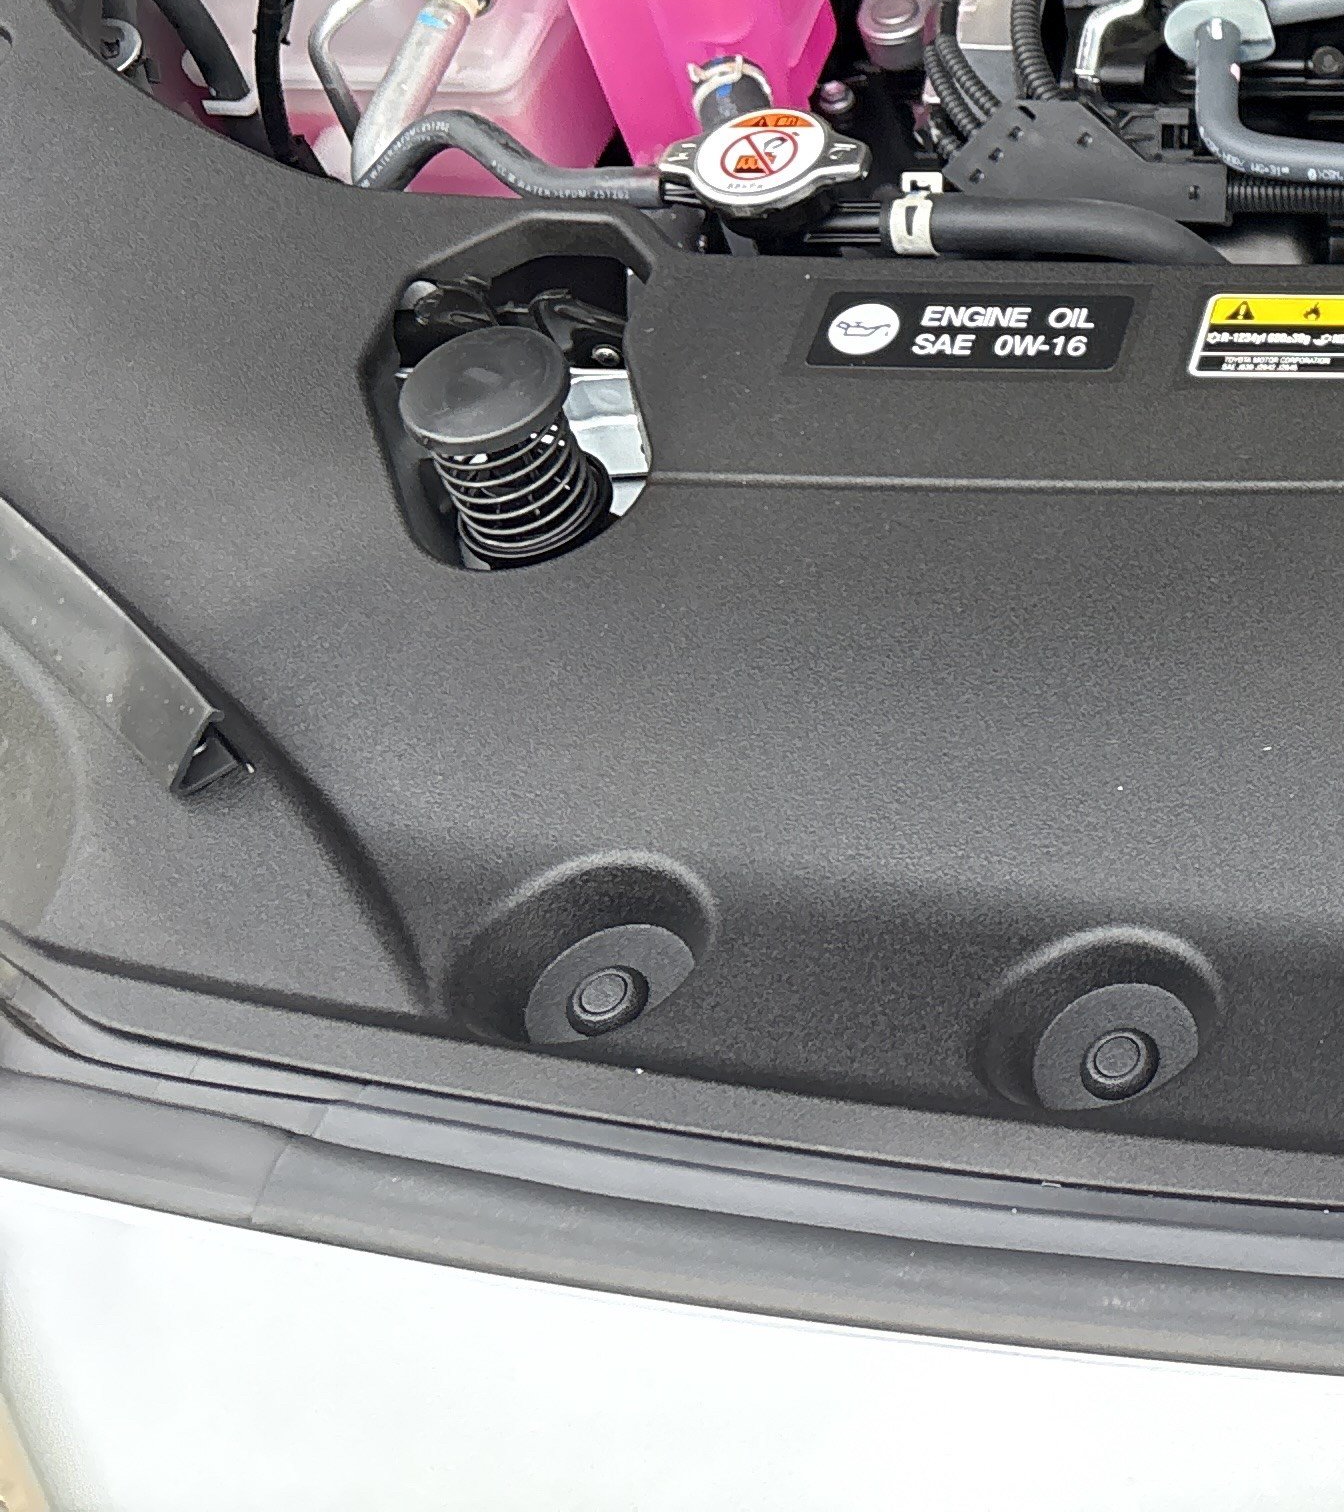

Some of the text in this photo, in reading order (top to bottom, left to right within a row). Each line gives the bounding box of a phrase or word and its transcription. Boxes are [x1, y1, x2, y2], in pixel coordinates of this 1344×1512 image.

[920, 305, 1096, 329] ENGINE OIL
[911, 333, 1088, 357] SAE 0W-16
[1252, 356, 1280, 364] MOTOR
